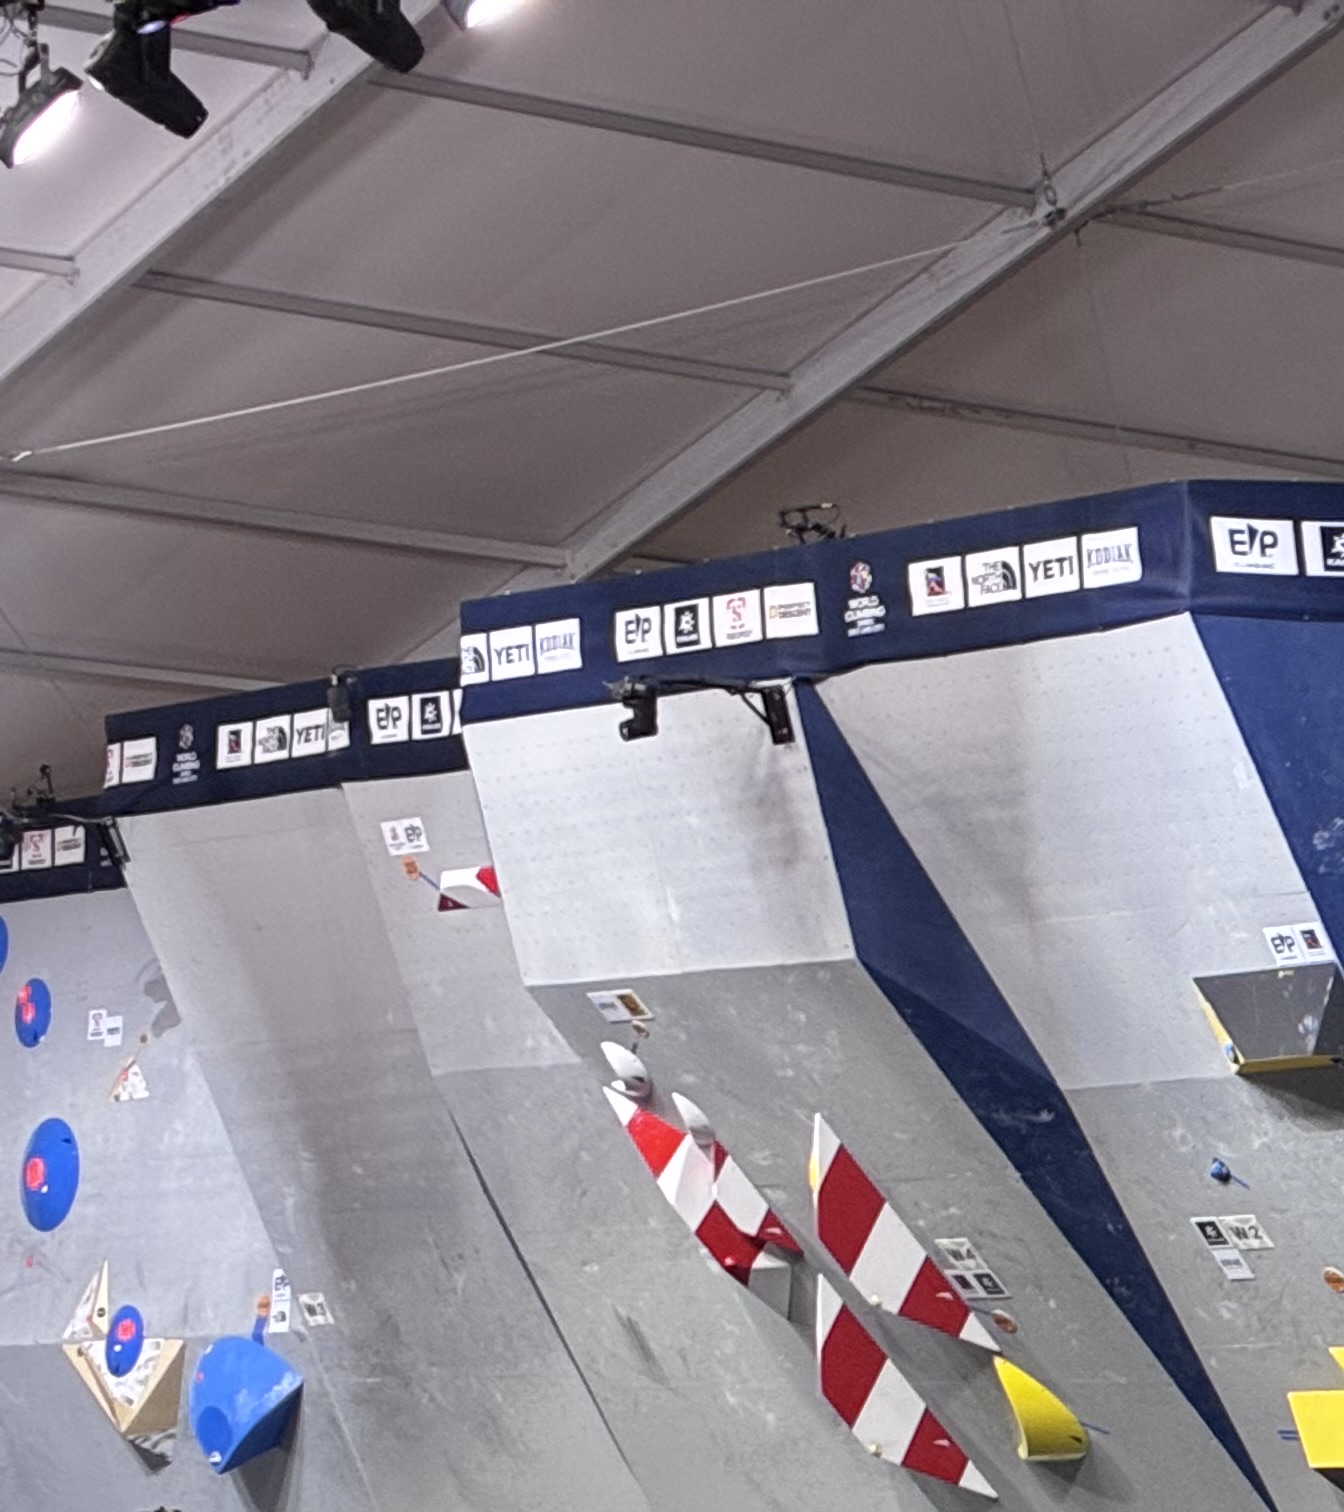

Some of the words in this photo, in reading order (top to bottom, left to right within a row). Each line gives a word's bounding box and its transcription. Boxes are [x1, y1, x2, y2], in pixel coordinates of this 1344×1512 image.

[982, 561, 1001, 572] THE
[1086, 543, 1134, 569] KODIAK
[1028, 555, 1075, 582] YETI
[494, 643, 530, 666] YETI
[296, 724, 325, 744] YETI
[1228, 1225, 1263, 1241] W2
